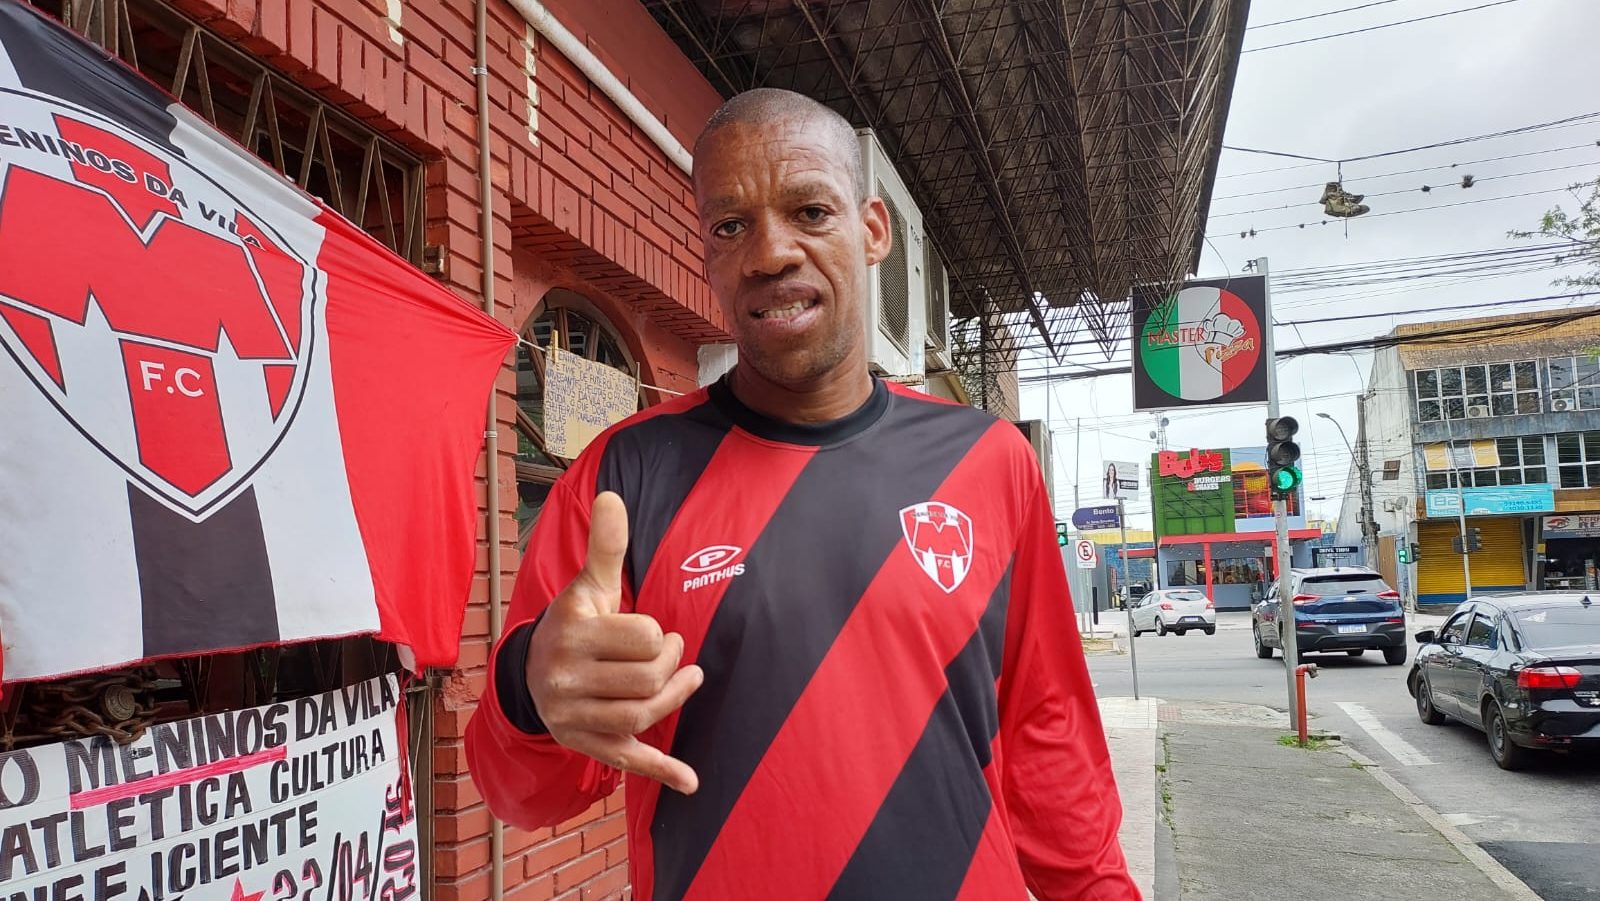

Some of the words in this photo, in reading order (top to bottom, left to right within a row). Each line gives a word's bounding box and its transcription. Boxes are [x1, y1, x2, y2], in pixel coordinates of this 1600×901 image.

[143, 171, 189, 209] DA
[198, 200, 268, 252] VILA
[1147, 327, 1206, 347] MASTER
[139, 360, 204, 398] F.C
[1193, 475, 1231, 484] BURGERS
[1093, 507, 1115, 515] Bento
[683, 563, 746, 593] PANTHUS
[64, 703, 289, 793] MENINOS
[295, 691, 337, 741] DA
[341, 675, 396, 726] VILA
[0, 771, 252, 882] ATLETICA
[270, 728, 386, 803] CULTURA
